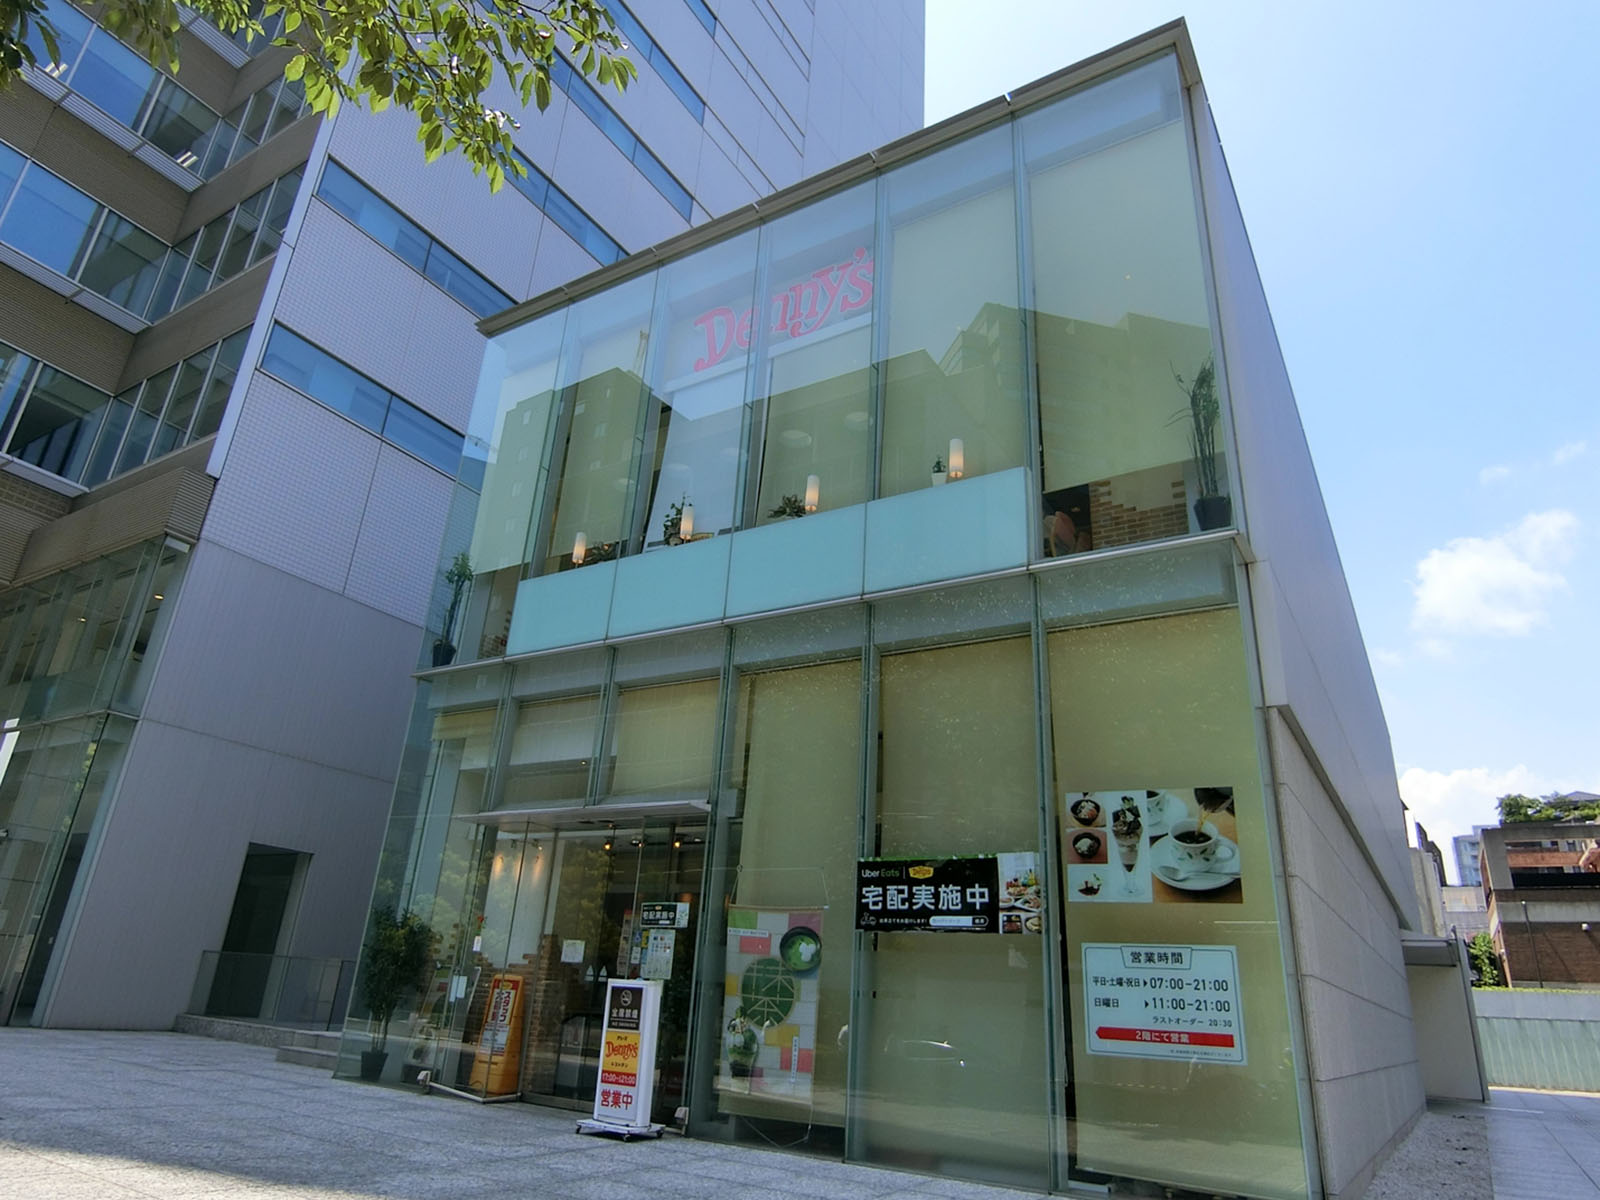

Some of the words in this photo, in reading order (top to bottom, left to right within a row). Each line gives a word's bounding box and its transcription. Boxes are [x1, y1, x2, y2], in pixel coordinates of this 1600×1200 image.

[693, 246, 874, 373] Denny's
[861, 869, 880, 878] Uber
[881, 868, 900, 878] Eats
[861, 883, 990, 912] 宅配実施中
[1130, 951, 1184, 965] 営業時間
[1094, 997, 1120, 1008] 日曜日
[1152, 1016, 1204, 1027] ラストオーダー
[1208, 1019, 1233, 1028] 20:30
[1135, 1030, 1191, 1044] 2階にて営業
[605, 1041, 638, 1060] Denny's
[601, 1088, 633, 1110] 営業中
